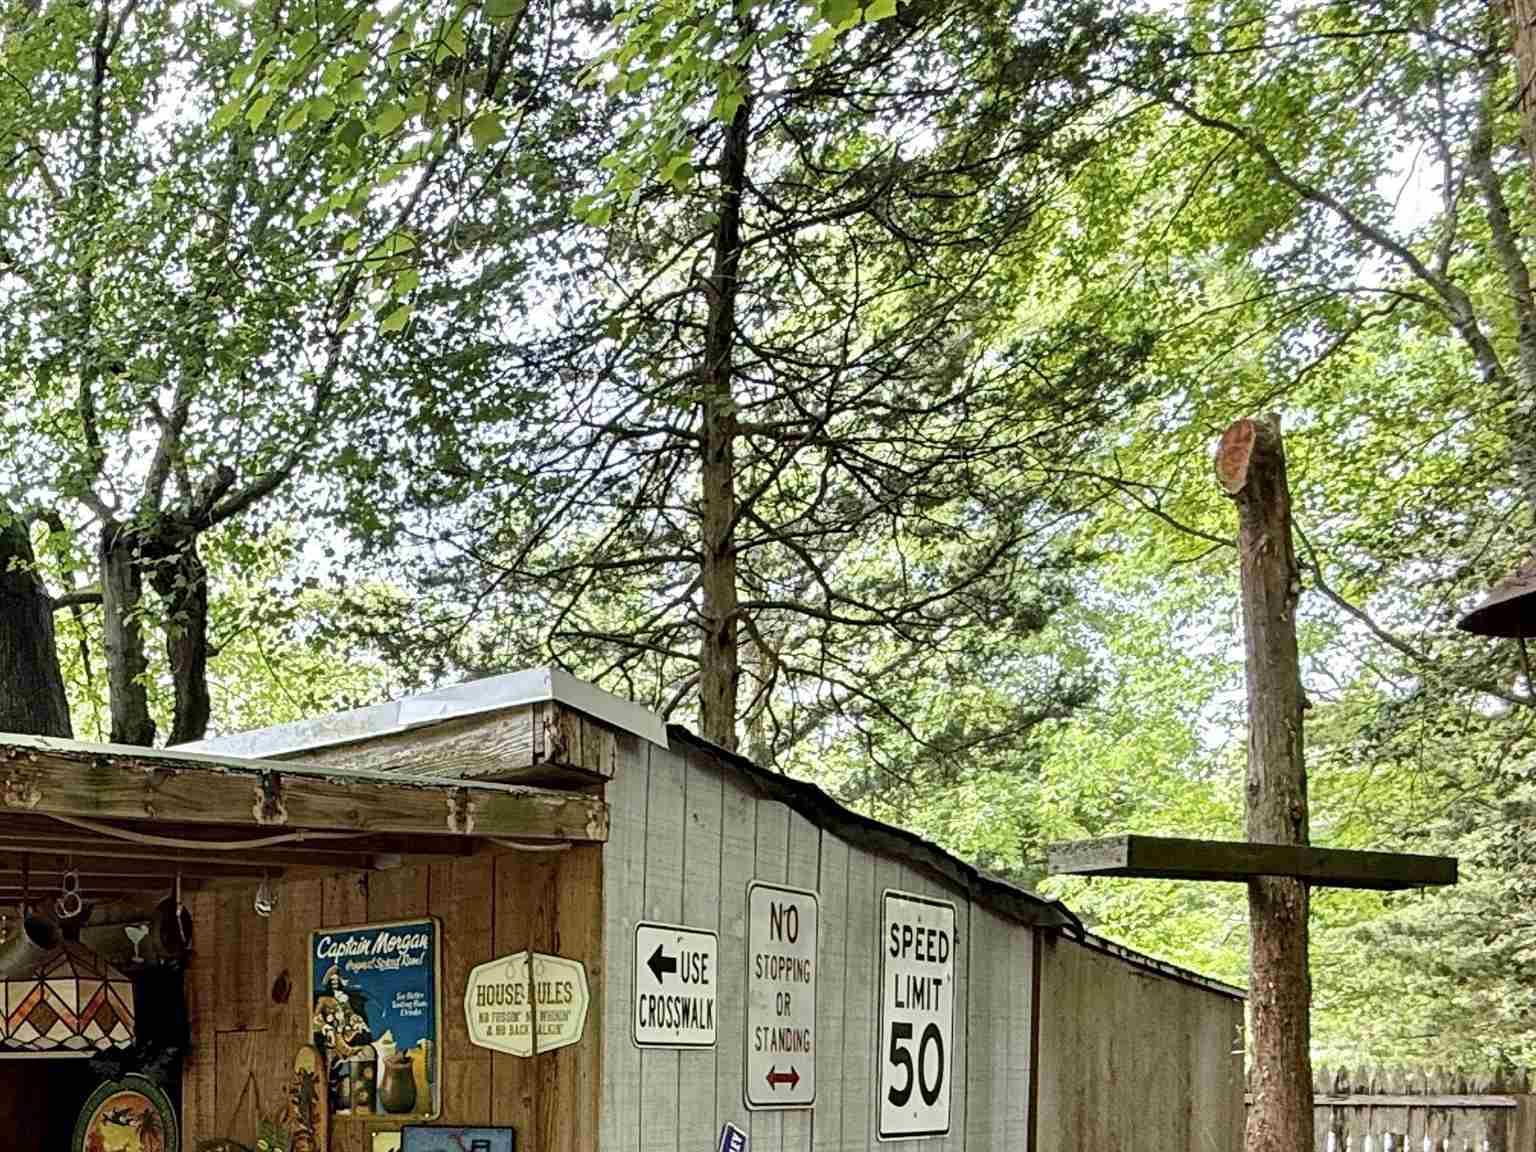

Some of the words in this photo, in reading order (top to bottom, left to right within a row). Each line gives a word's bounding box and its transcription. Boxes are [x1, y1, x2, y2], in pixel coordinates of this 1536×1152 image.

[769, 901, 799, 945] NO
[316, 935, 370, 963] Captain
[370, 930, 429, 955] Morgan
[889, 922, 950, 965] SPEED
[680, 952, 710, 985] USE
[755, 953, 811, 984] STOPPING
[476, 983, 524, 1007] HOUSE
[528, 981, 573, 1005] ULES
[776, 991, 792, 1017] OR
[894, 973, 944, 1012] LIMIT
[638, 993, 714, 1031] CROSSWALK
[754, 1026, 811, 1053] STANDING
[887, 1021, 945, 1108] 50
